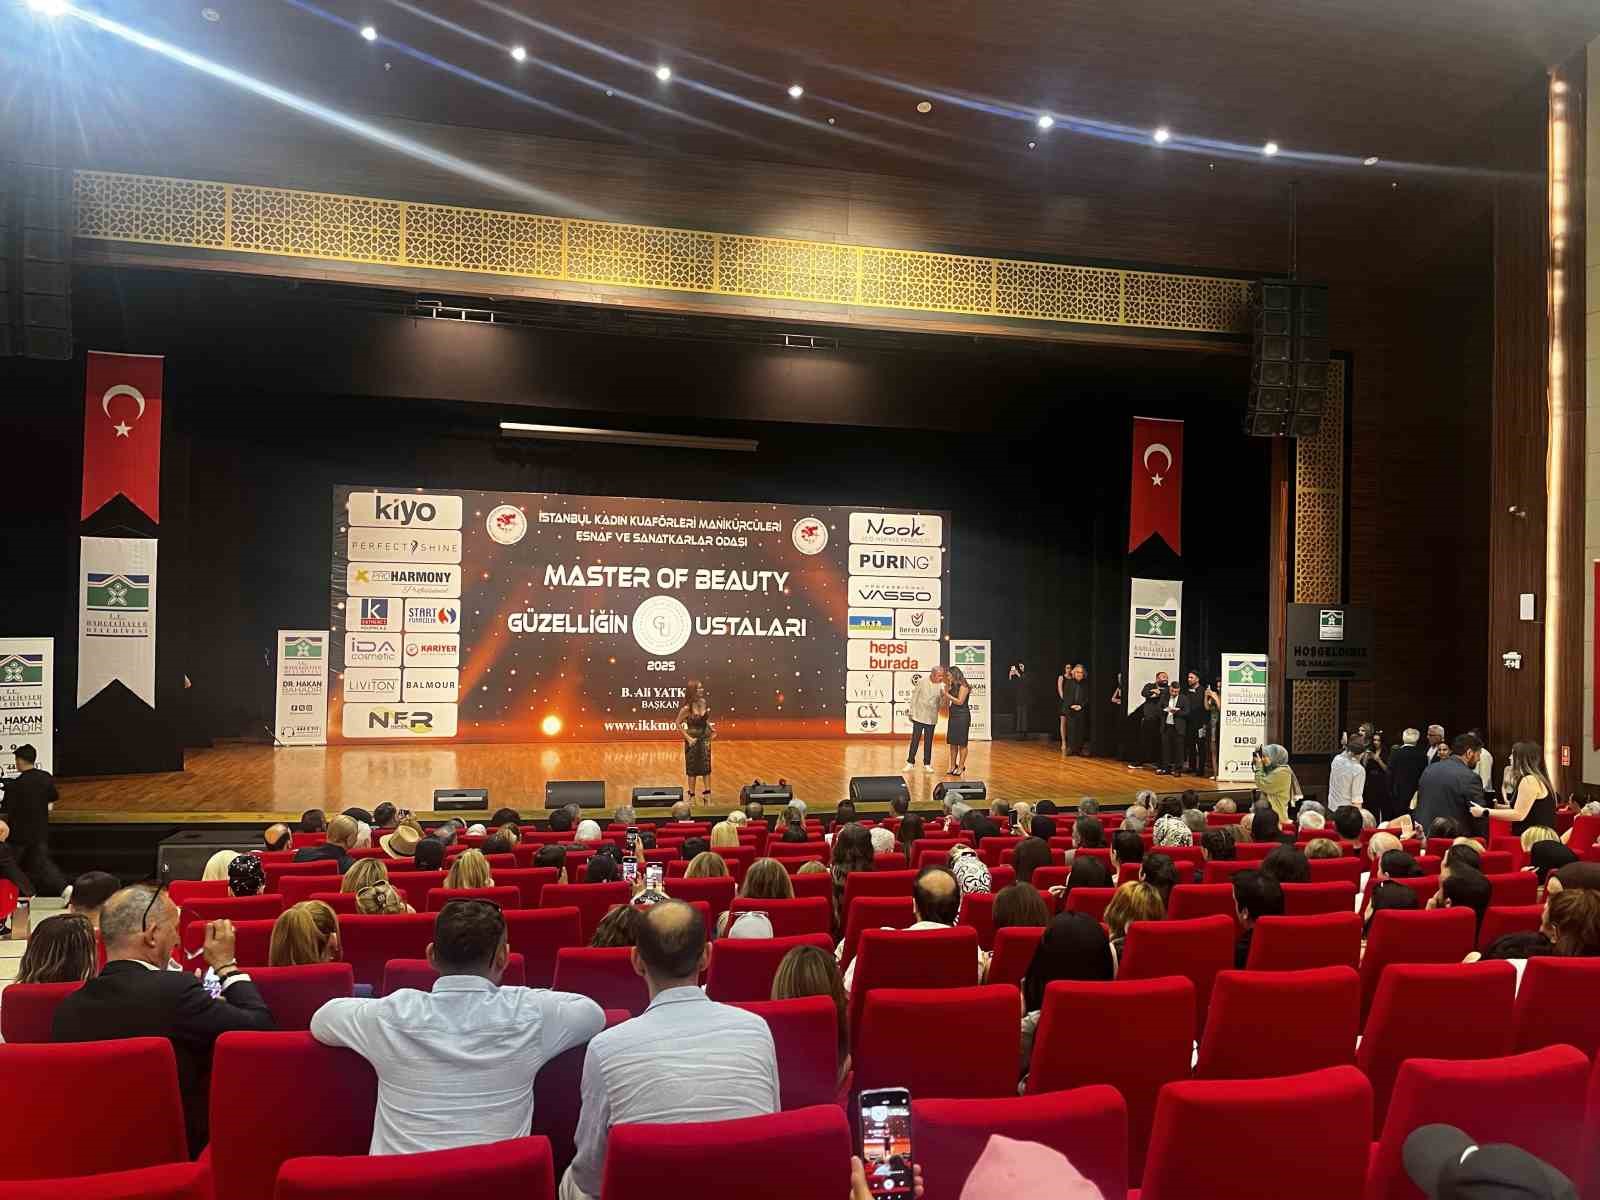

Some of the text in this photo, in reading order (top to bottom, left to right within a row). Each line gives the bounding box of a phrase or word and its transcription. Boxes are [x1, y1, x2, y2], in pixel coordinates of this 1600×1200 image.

[375, 495, 436, 526] kiyo
[594, 514, 628, 526] KADIN
[629, 514, 697, 529] KUAFÖRLERİ
[866, 517, 925, 537] Nook
[575, 530, 748, 547] ESNAF VE SANATKARLAR ODASI
[351, 542, 458, 553] PERFECT SHINE
[543, 564, 790, 592] MASTER OF BEAUTY
[858, 589, 932, 602] VASSO
[408, 607, 437, 617] START
[507, 607, 808, 638] GÜZELLİĞİN USTALARI
[869, 641, 908, 656] hepsi
[646, 660, 676, 672] 2025
[869, 656, 919, 670] burada
[406, 681, 456, 690] BALMOUR
[641, 700, 680, 711] BAŞKAN
[4, 715, 43, 725] HAKAN
[1240, 710, 1266, 718] HAKAN
